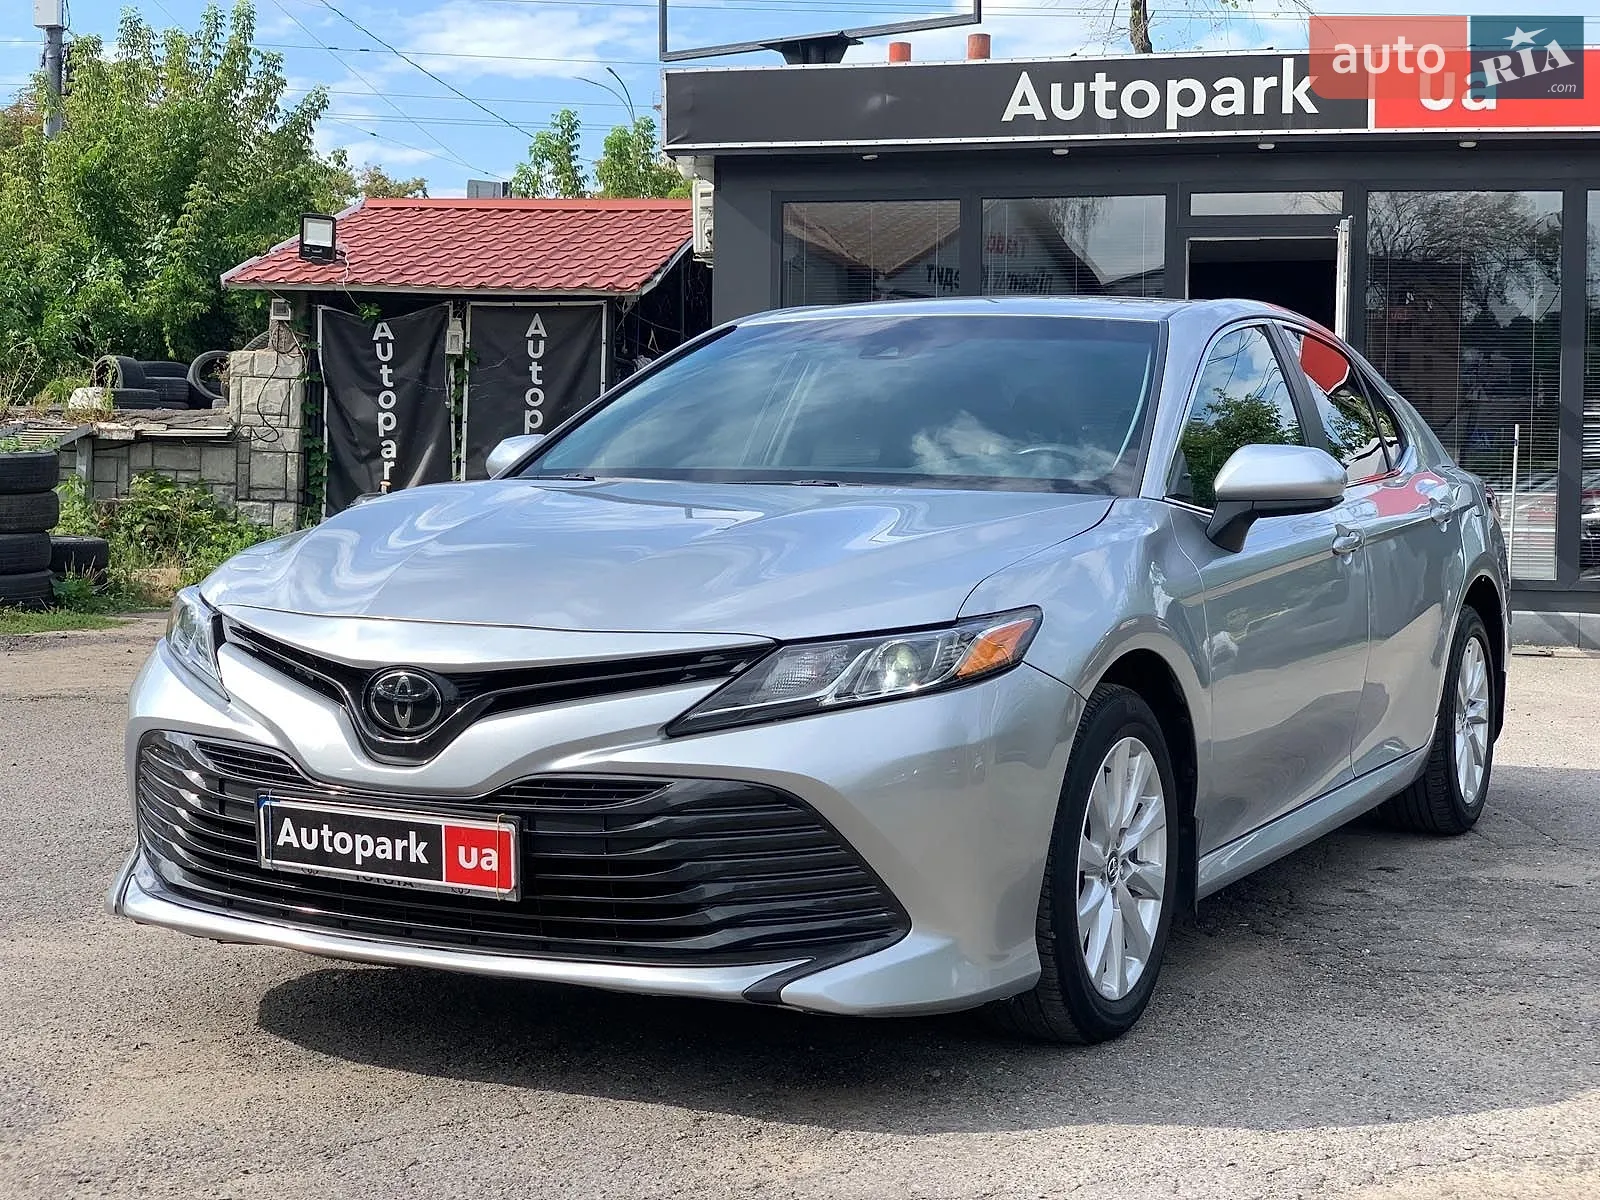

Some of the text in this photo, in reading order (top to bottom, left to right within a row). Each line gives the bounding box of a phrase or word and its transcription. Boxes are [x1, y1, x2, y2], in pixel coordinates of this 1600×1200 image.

[1001, 57, 1320, 129] Autopark
[372, 322, 398, 494] Autopar
[276, 817, 499, 871] Autopark ua
